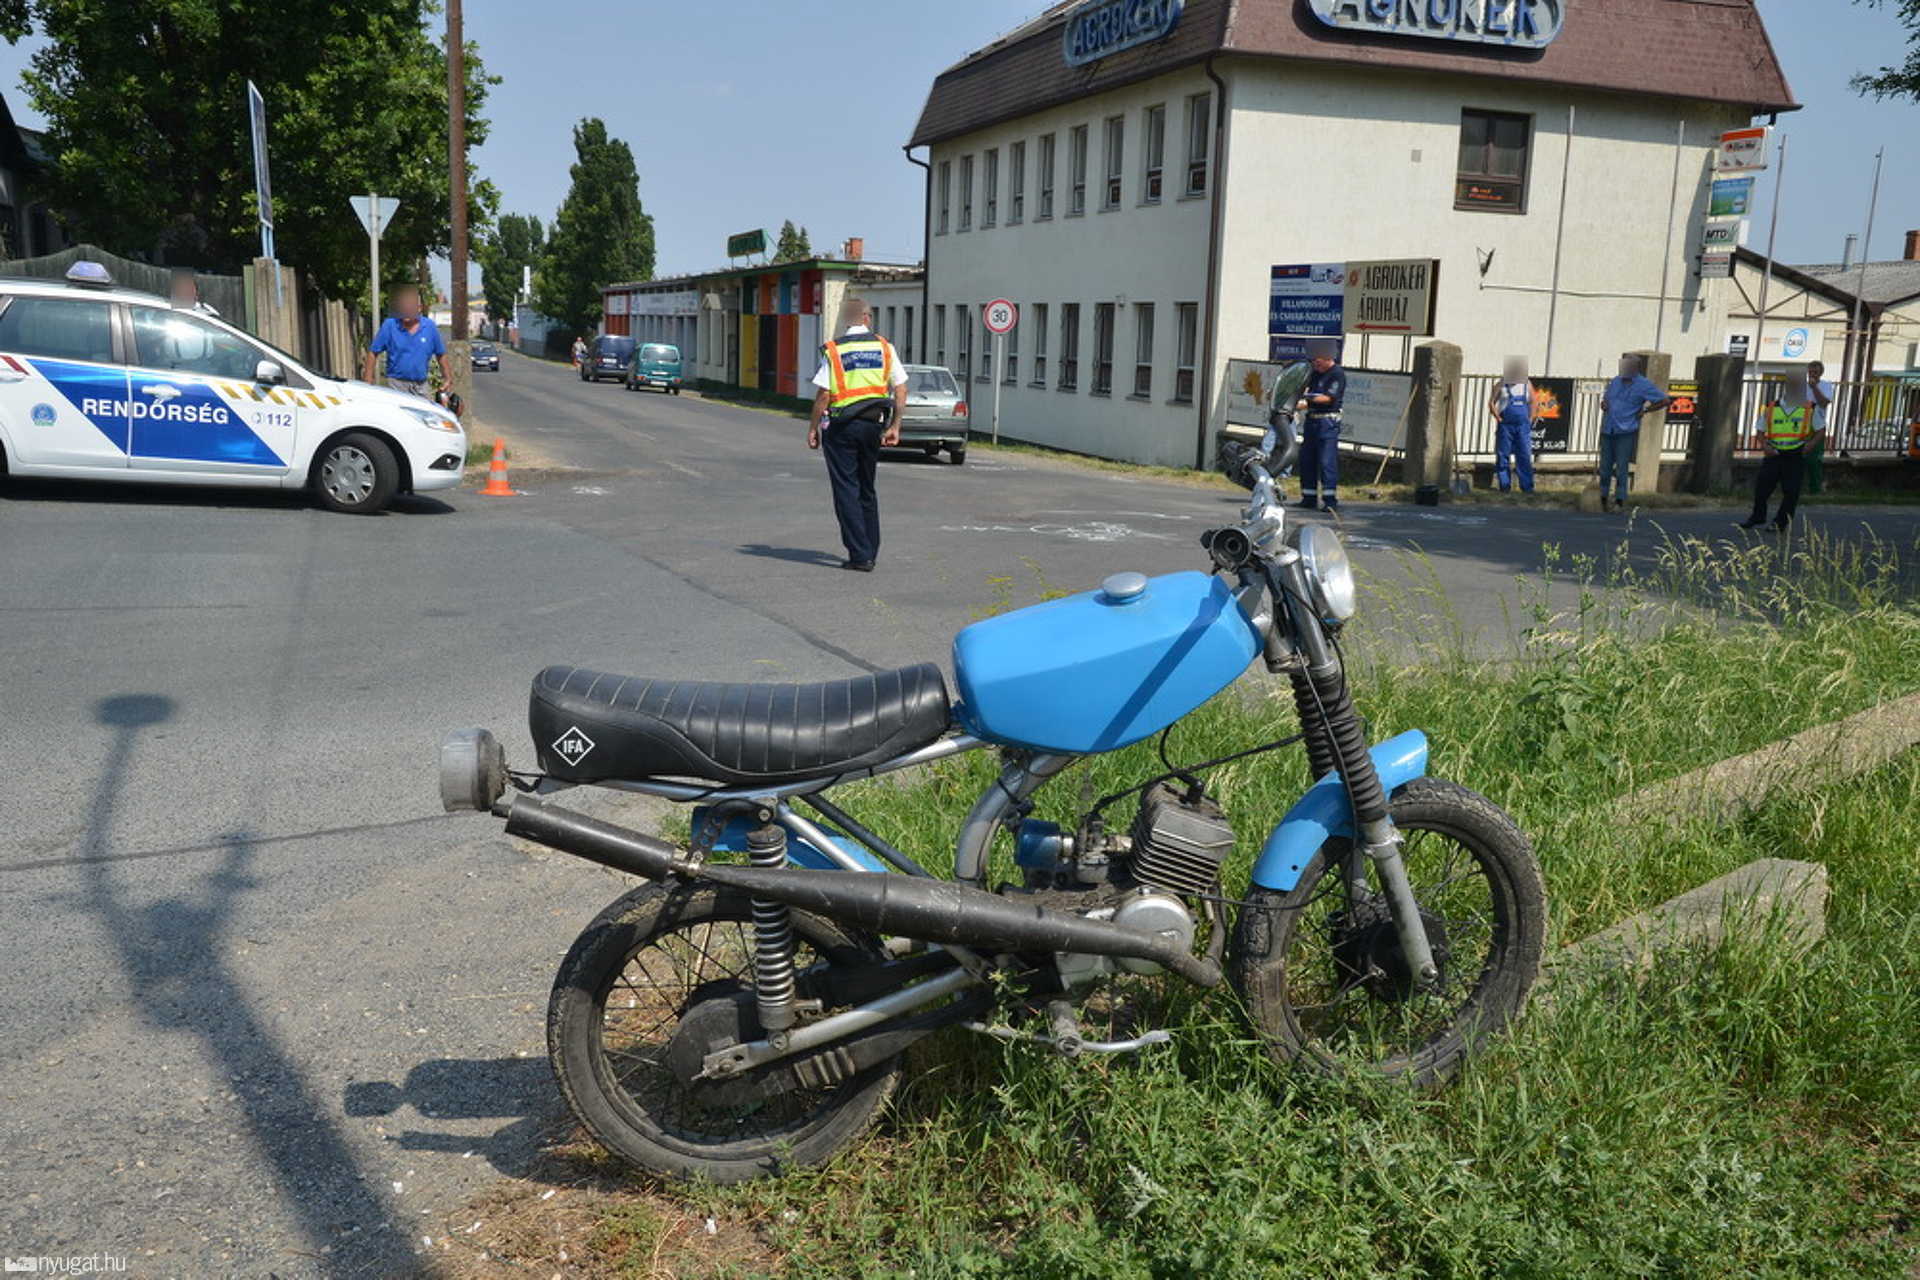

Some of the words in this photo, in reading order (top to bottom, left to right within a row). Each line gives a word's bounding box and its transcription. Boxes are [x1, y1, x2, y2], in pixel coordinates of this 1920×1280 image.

[1363, 264, 1426, 290] AGROKER
[992, 309, 1009, 323] 30
[1358, 293, 1409, 321] ÁRUHÁZ
[82, 397, 230, 425] RENDŐRSÉG
[266, 413, 293, 427] 112
[563, 738, 585, 754] IFA
